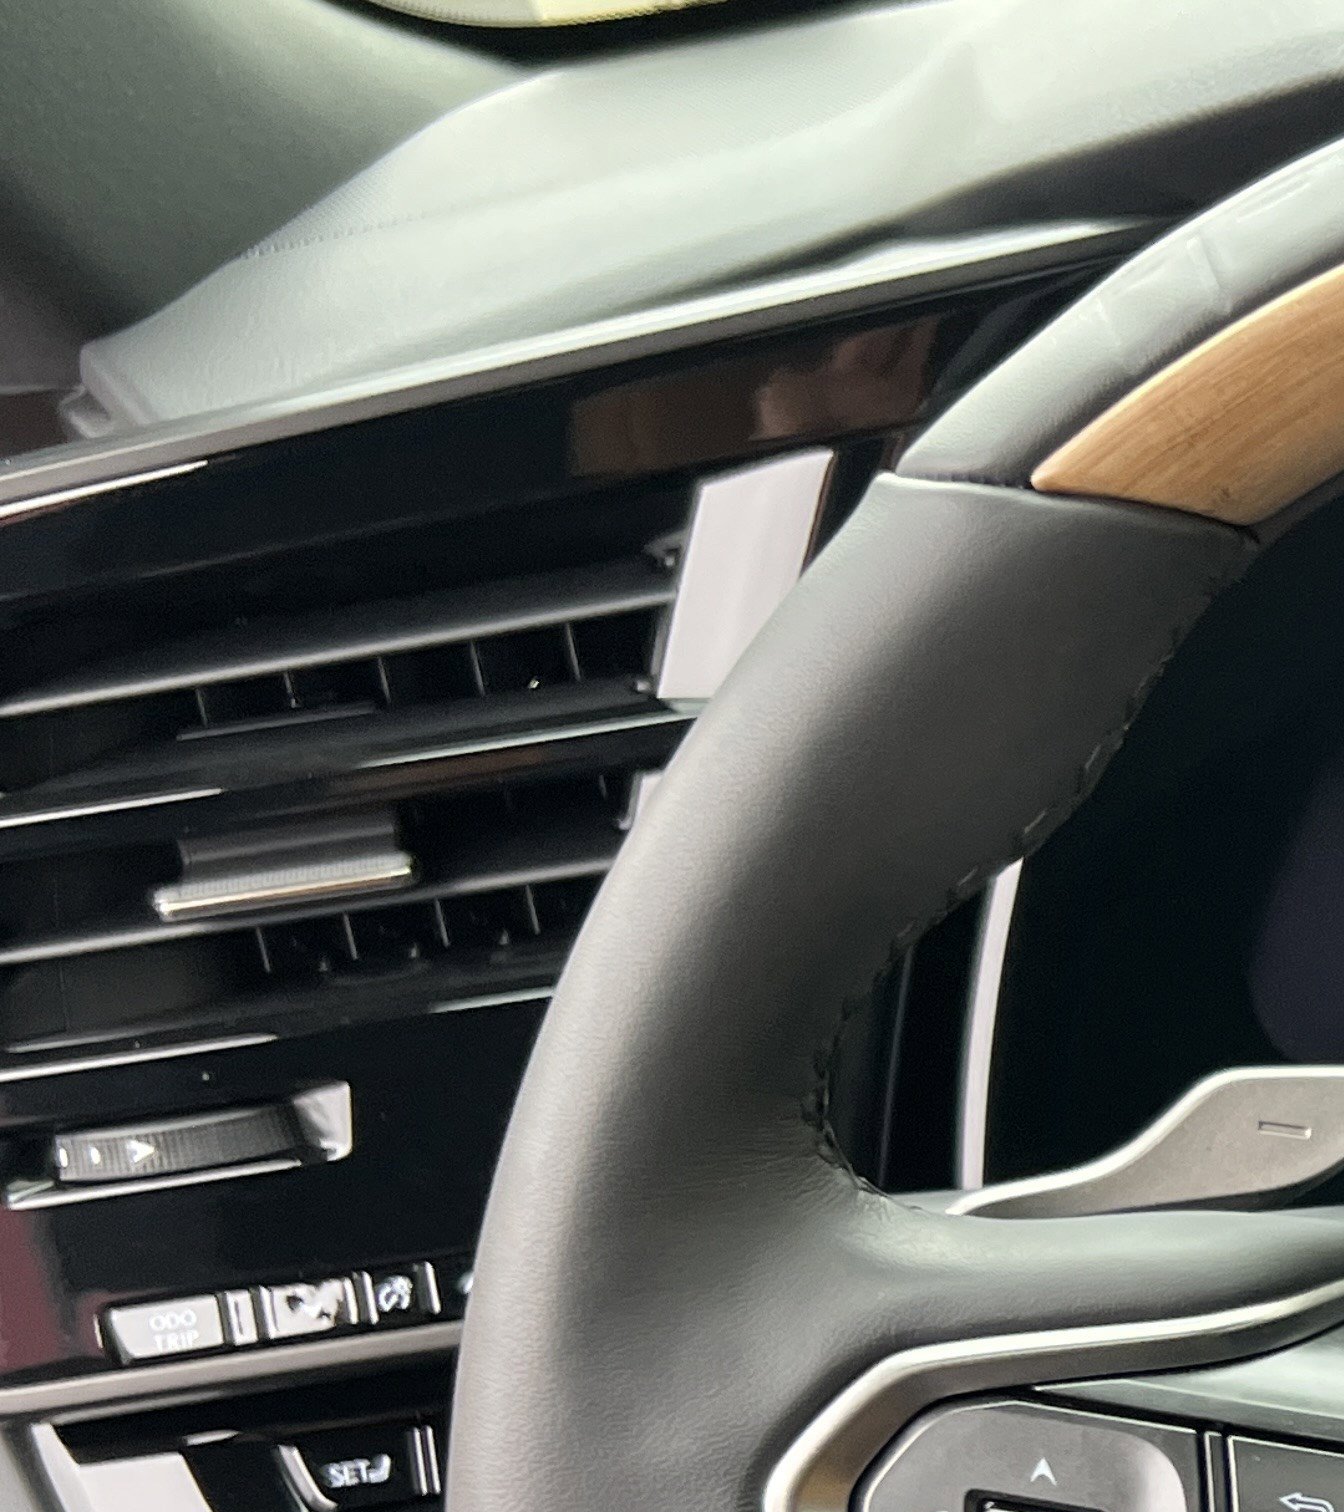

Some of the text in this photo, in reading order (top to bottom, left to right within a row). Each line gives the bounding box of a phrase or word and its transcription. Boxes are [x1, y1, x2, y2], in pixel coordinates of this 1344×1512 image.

[149, 1309, 197, 1332] ODO
[155, 1329, 199, 1353] TRIP
[324, 1458, 371, 1488] SET
